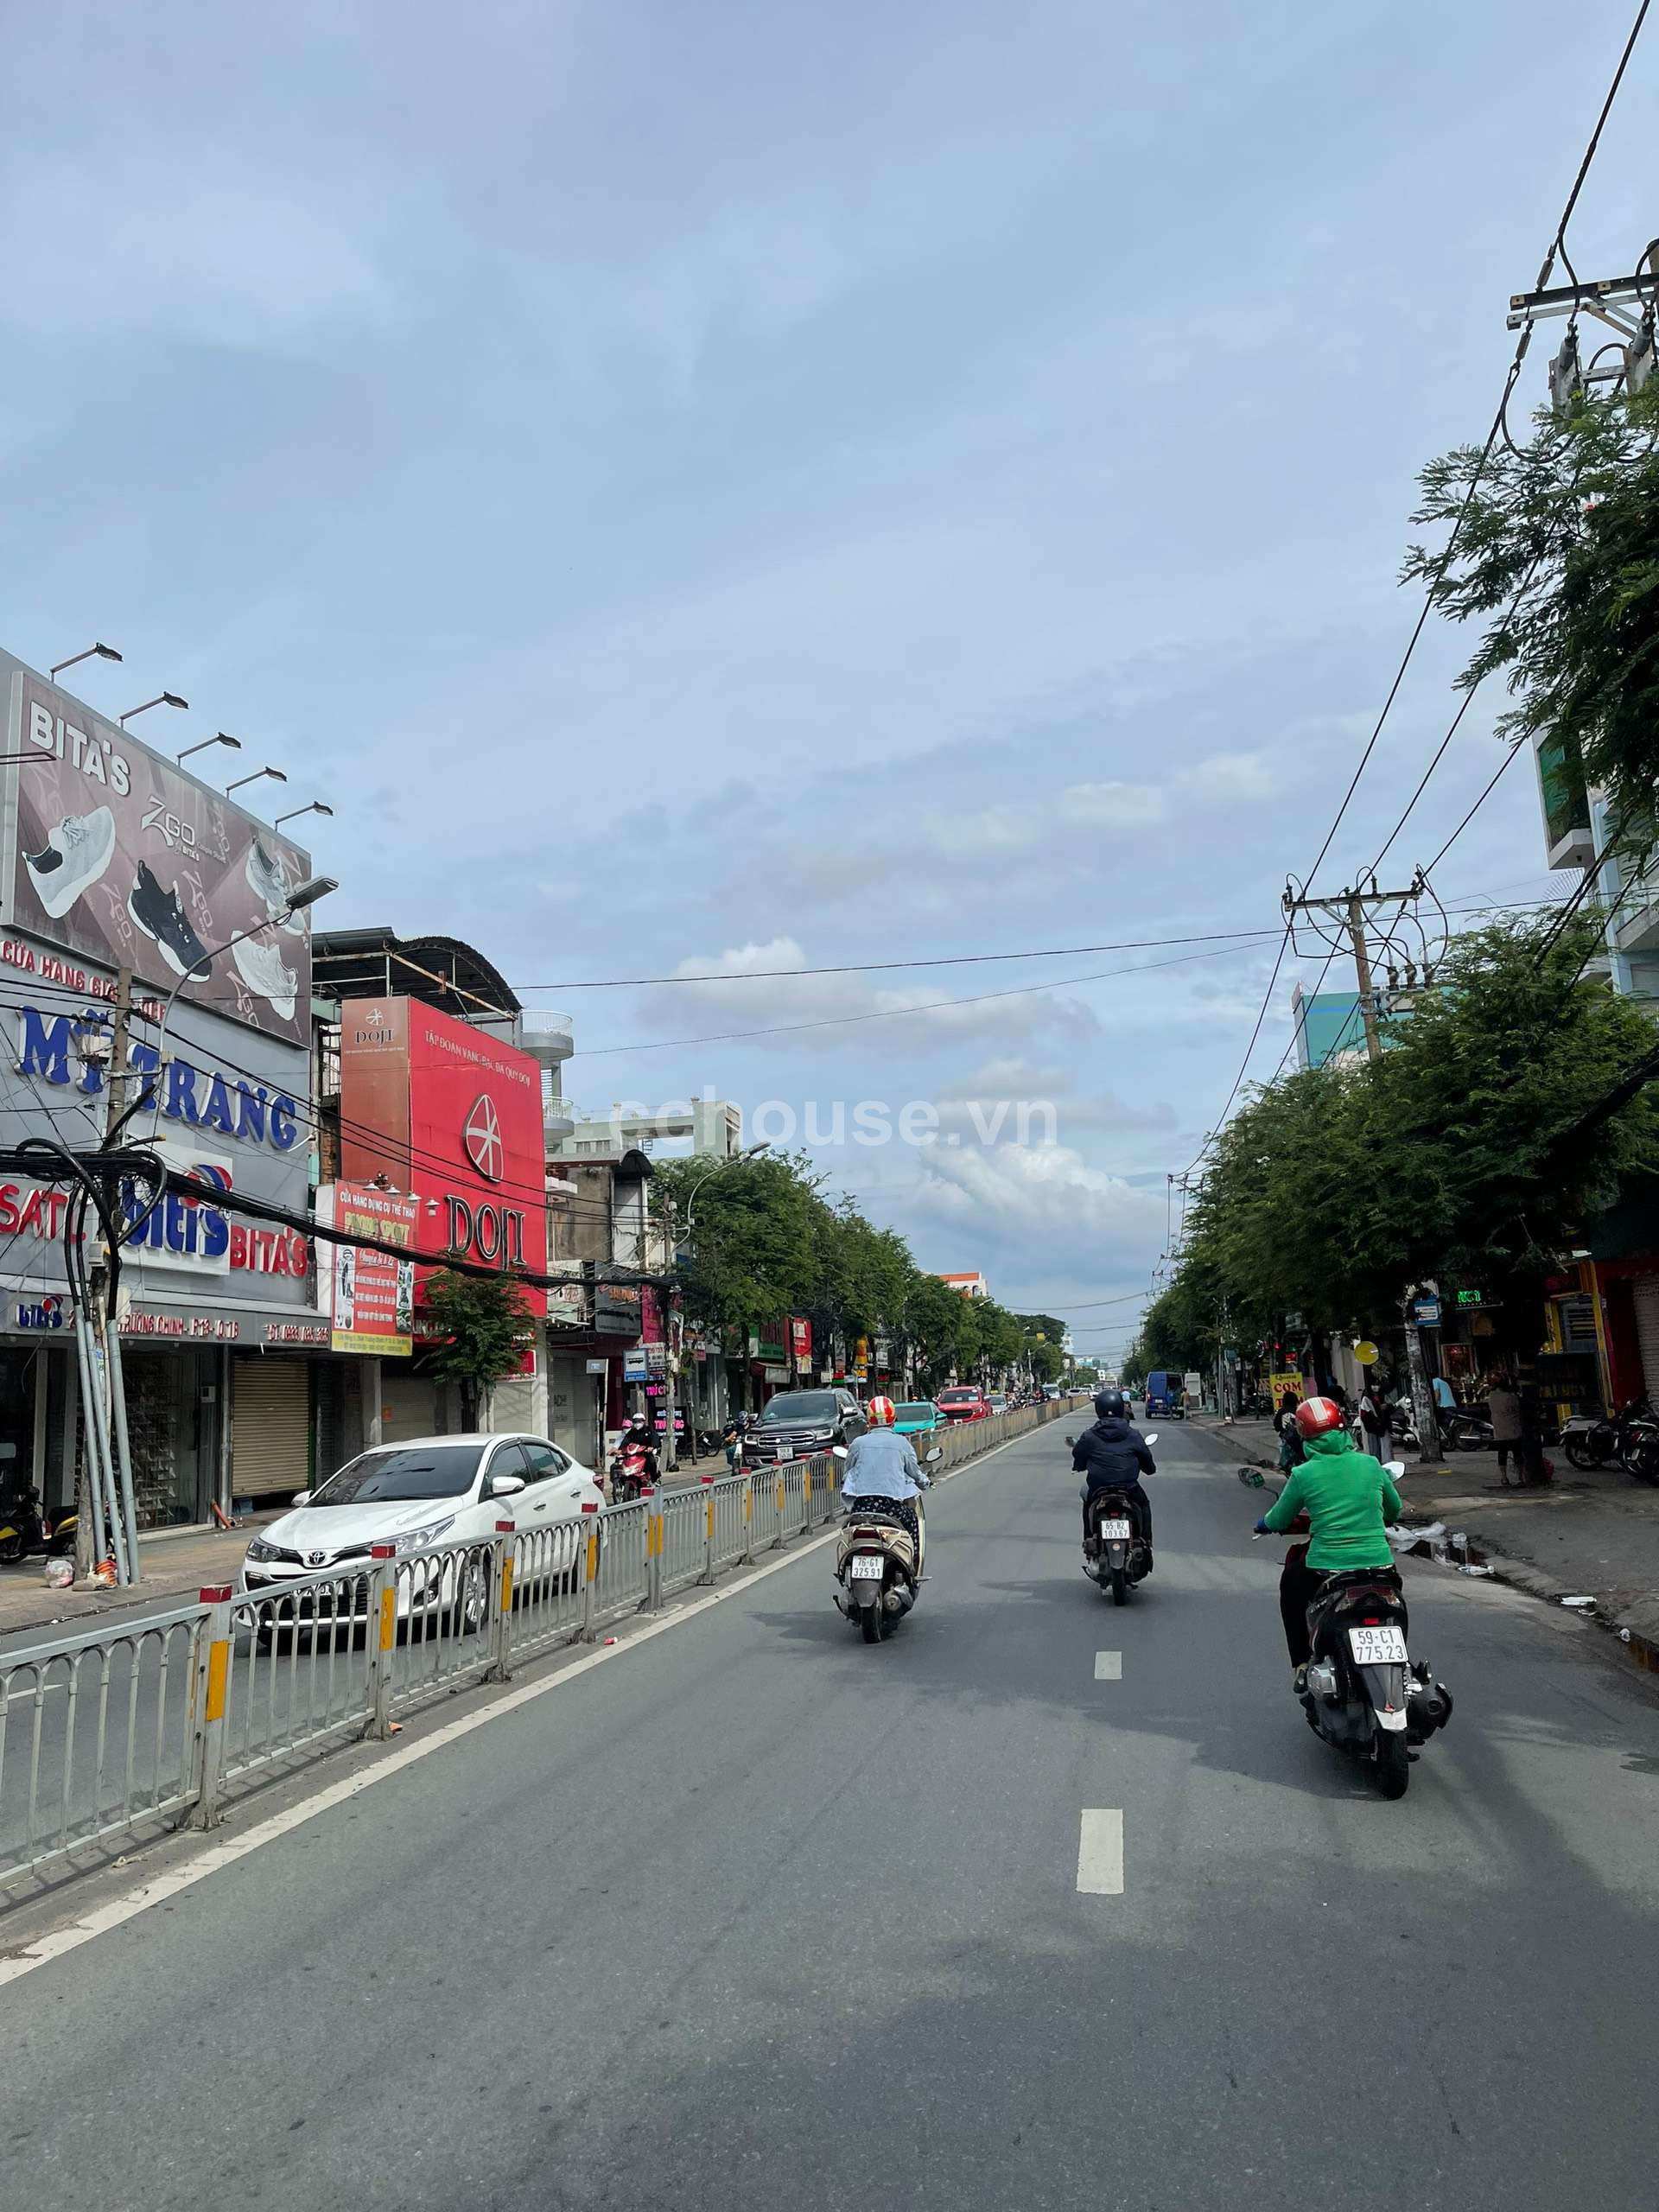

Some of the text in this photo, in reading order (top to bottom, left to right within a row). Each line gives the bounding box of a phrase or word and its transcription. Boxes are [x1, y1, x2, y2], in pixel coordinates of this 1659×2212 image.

[29, 700, 130, 797] BITA'S
[354, 1027, 395, 1046] DOJI
[230, 1224, 308, 1278] BITA'S
[448, 1194, 527, 1271] DOJI
